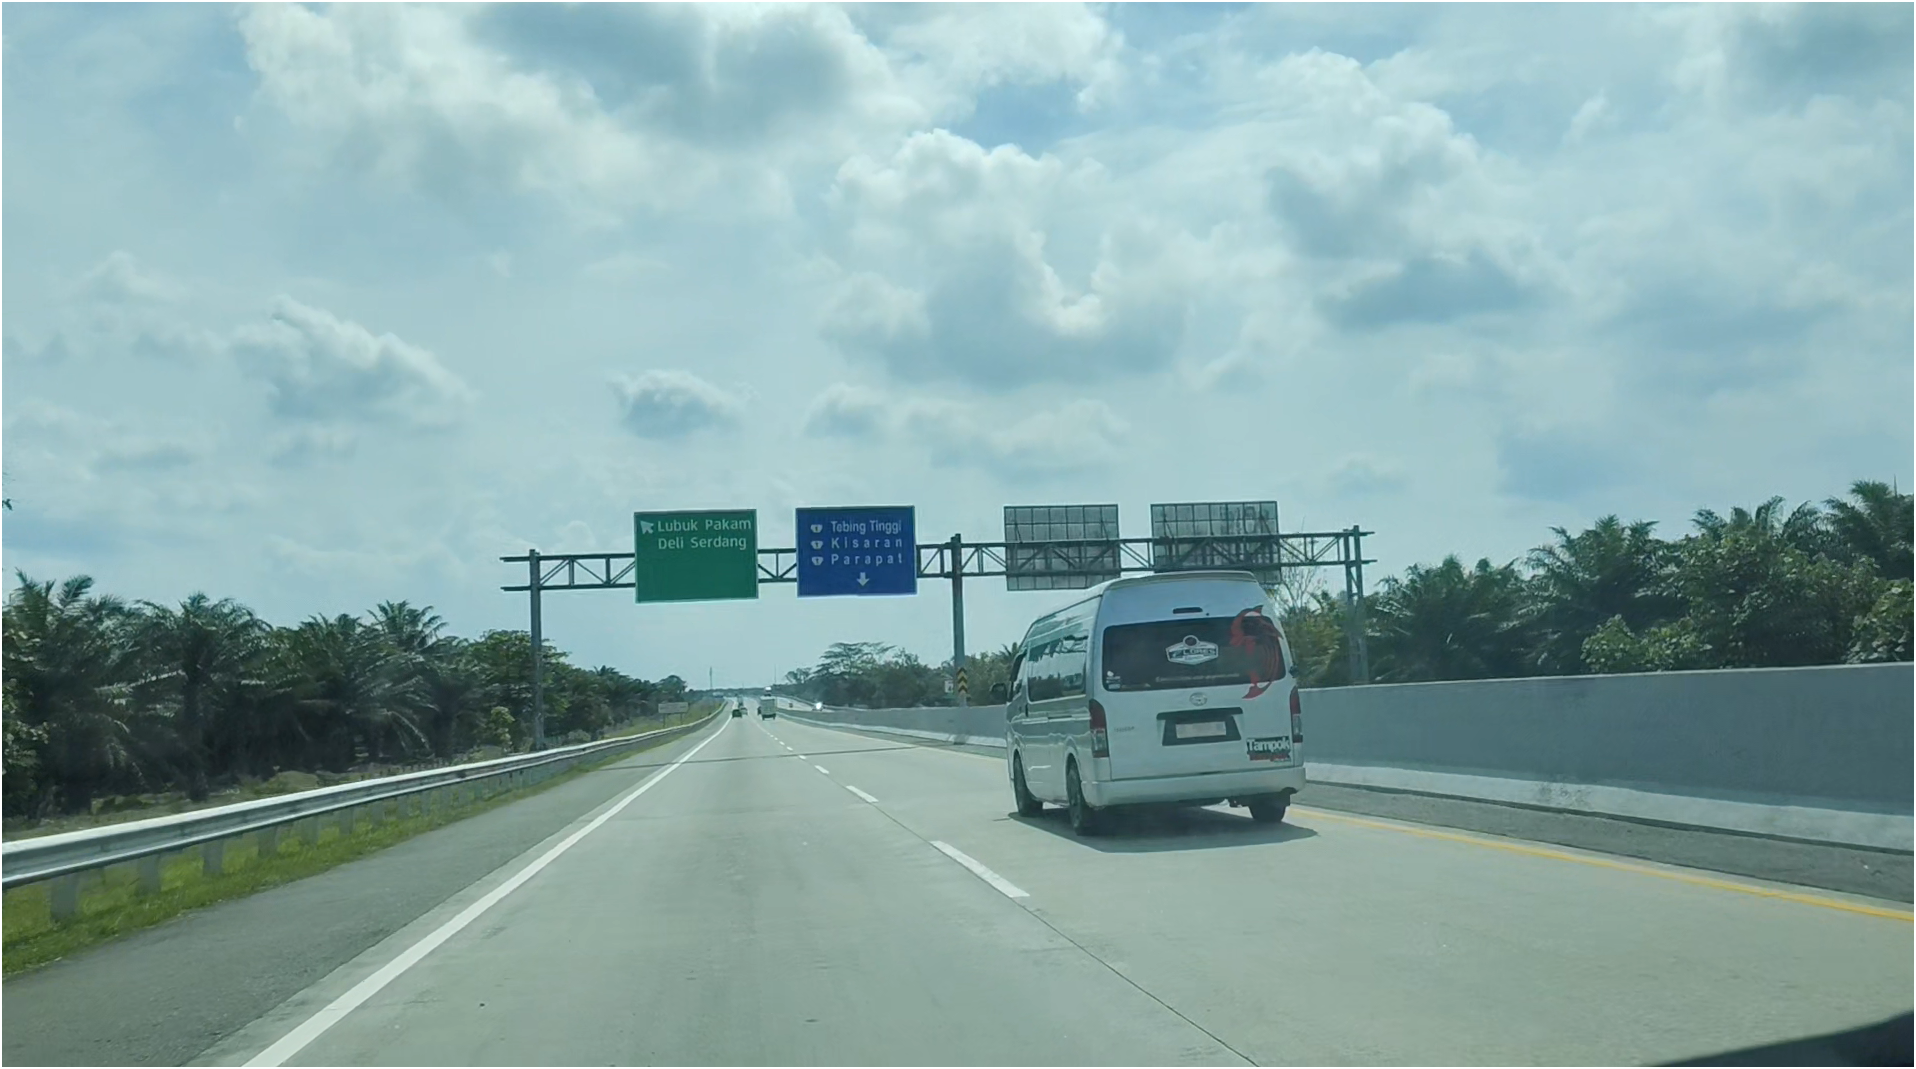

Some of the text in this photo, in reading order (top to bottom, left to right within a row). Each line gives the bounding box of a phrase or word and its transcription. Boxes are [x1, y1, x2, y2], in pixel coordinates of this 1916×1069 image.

[657, 518, 752, 532] Lubuk Pakam
[830, 520, 866, 535] Tebing
[869, 519, 902, 535] Tinggi
[658, 536, 747, 551] Deli Serdang
[831, 536, 903, 549] Kisaran
[831, 552, 903, 567] Parapat
[1246, 736, 1290, 752] Tampok
